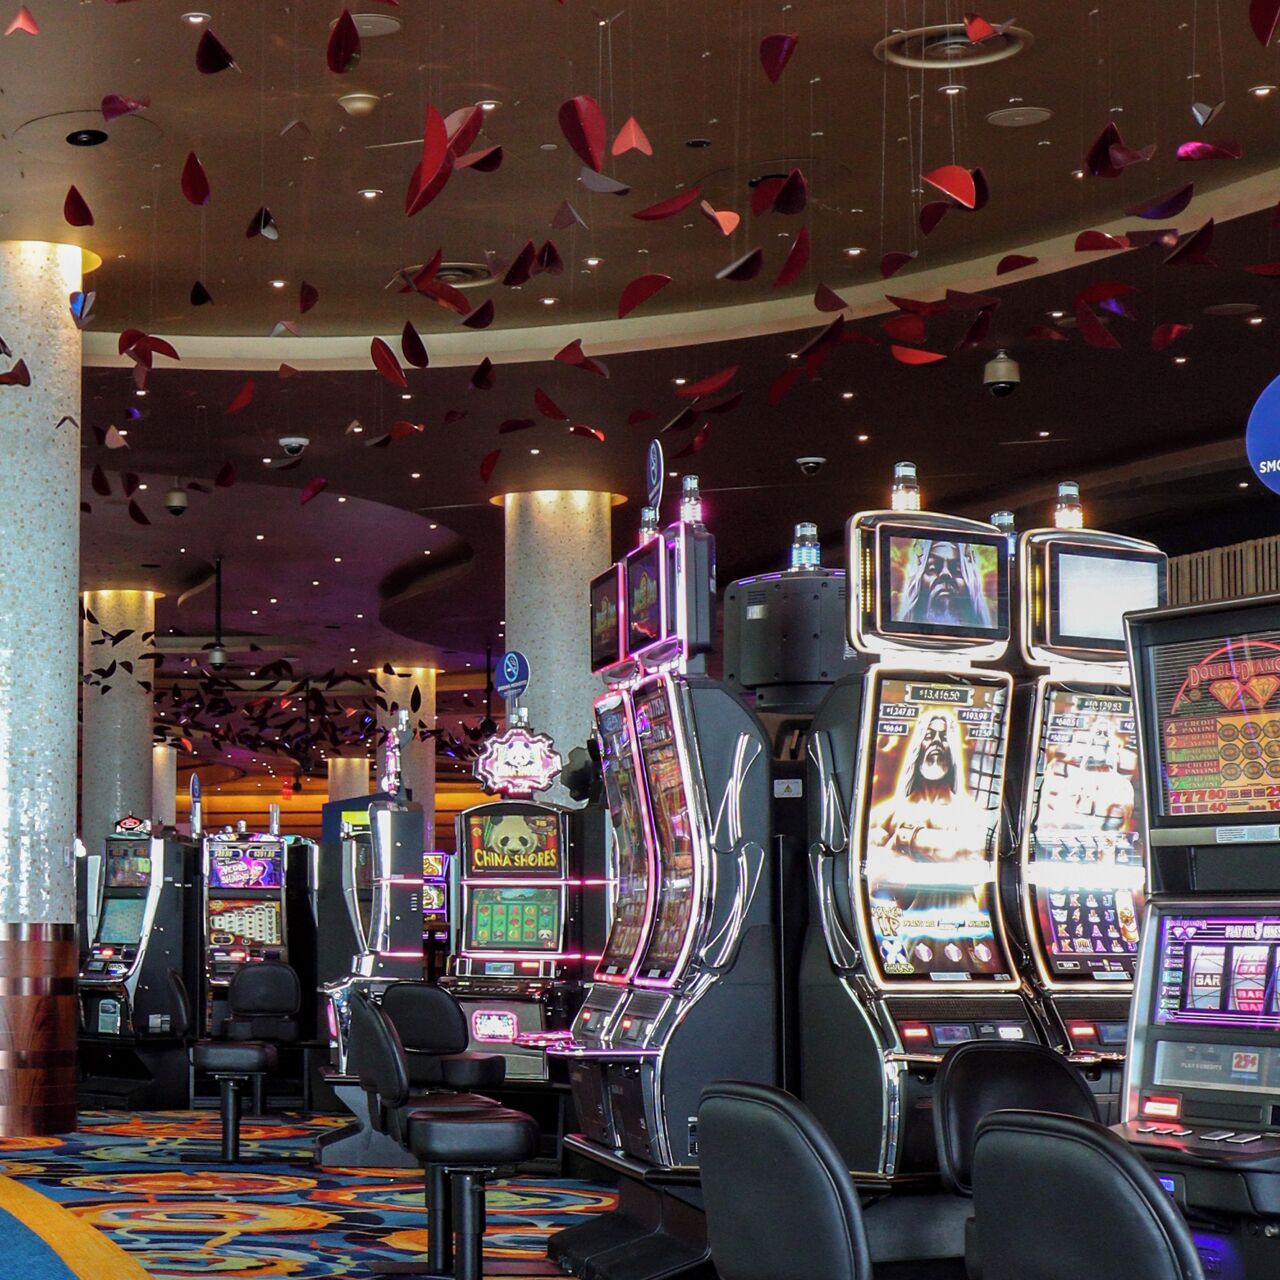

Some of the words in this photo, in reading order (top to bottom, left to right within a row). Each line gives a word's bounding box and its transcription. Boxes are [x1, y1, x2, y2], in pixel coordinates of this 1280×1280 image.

[474, 848, 512, 866] CHINA
[514, 849, 557, 867] SHORES
[1195, 974, 1220, 986] BAR
[1237, 990, 1264, 999] BAR
[1234, 1054, 1257, 1069] 25¢
